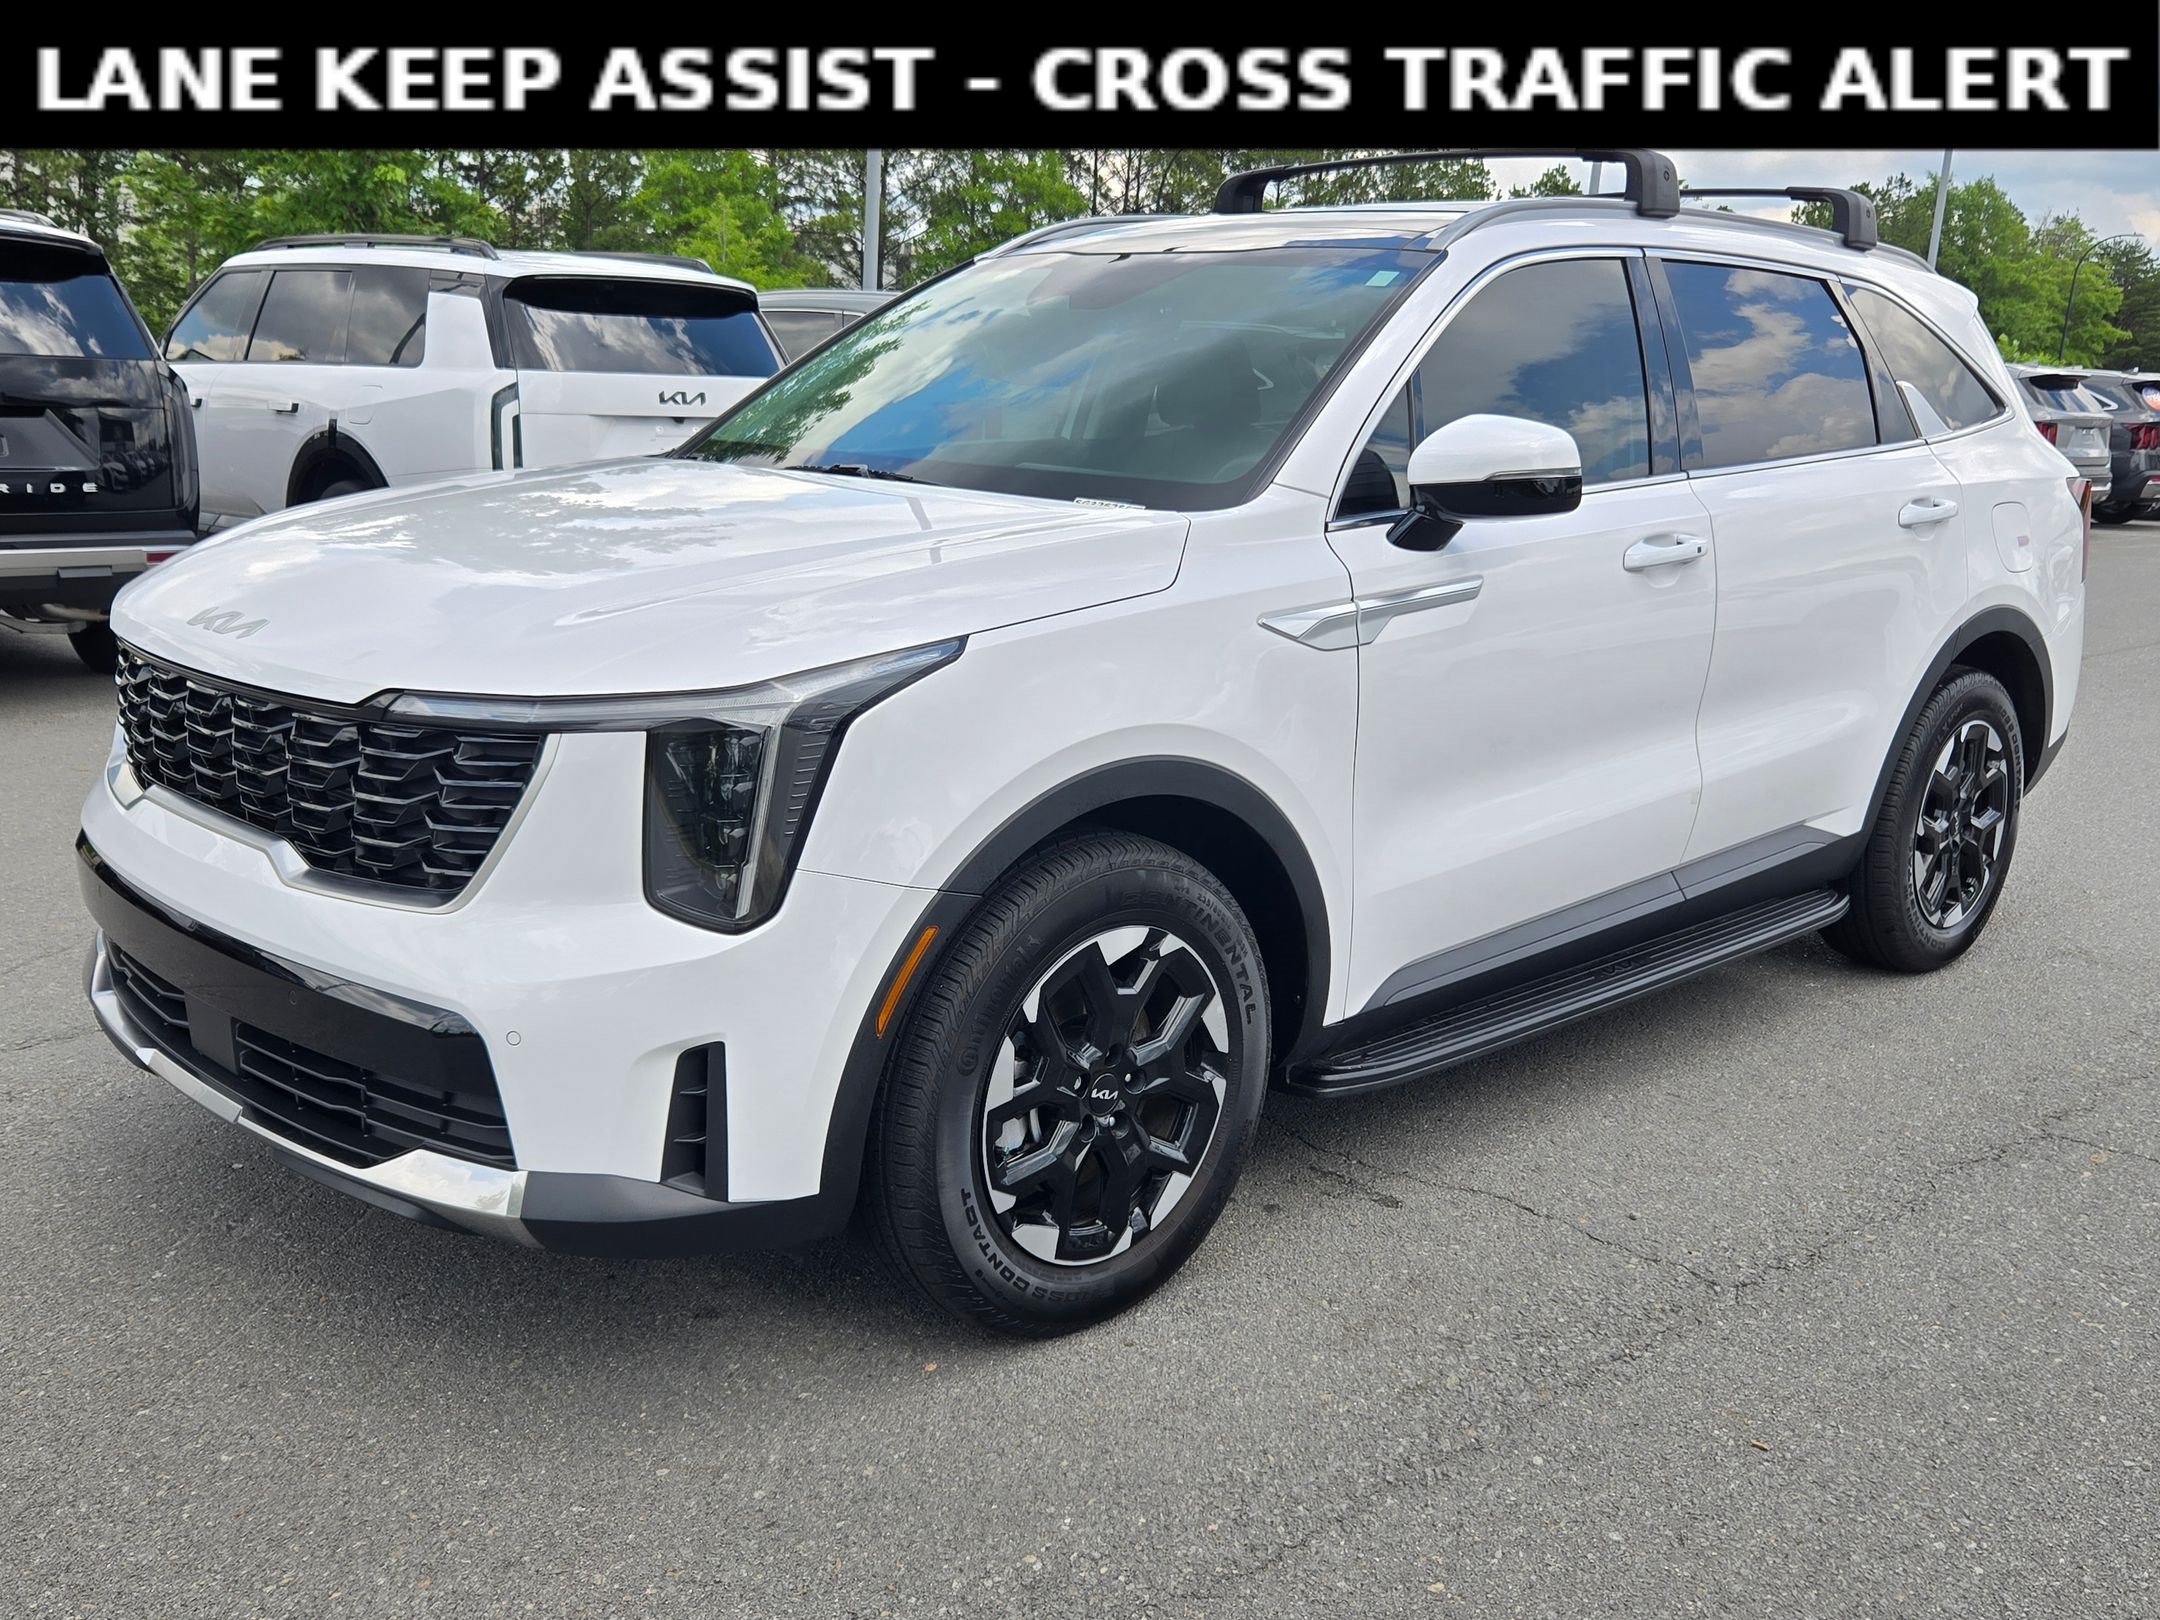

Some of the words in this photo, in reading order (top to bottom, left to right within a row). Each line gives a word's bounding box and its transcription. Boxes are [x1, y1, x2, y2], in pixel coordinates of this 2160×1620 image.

[658, 390, 706, 406] KIA
[186, 606, 271, 639] KIA
[1121, 890, 1257, 1025] CONTINENTAL
[1091, 1088, 1119, 1100] KIA
